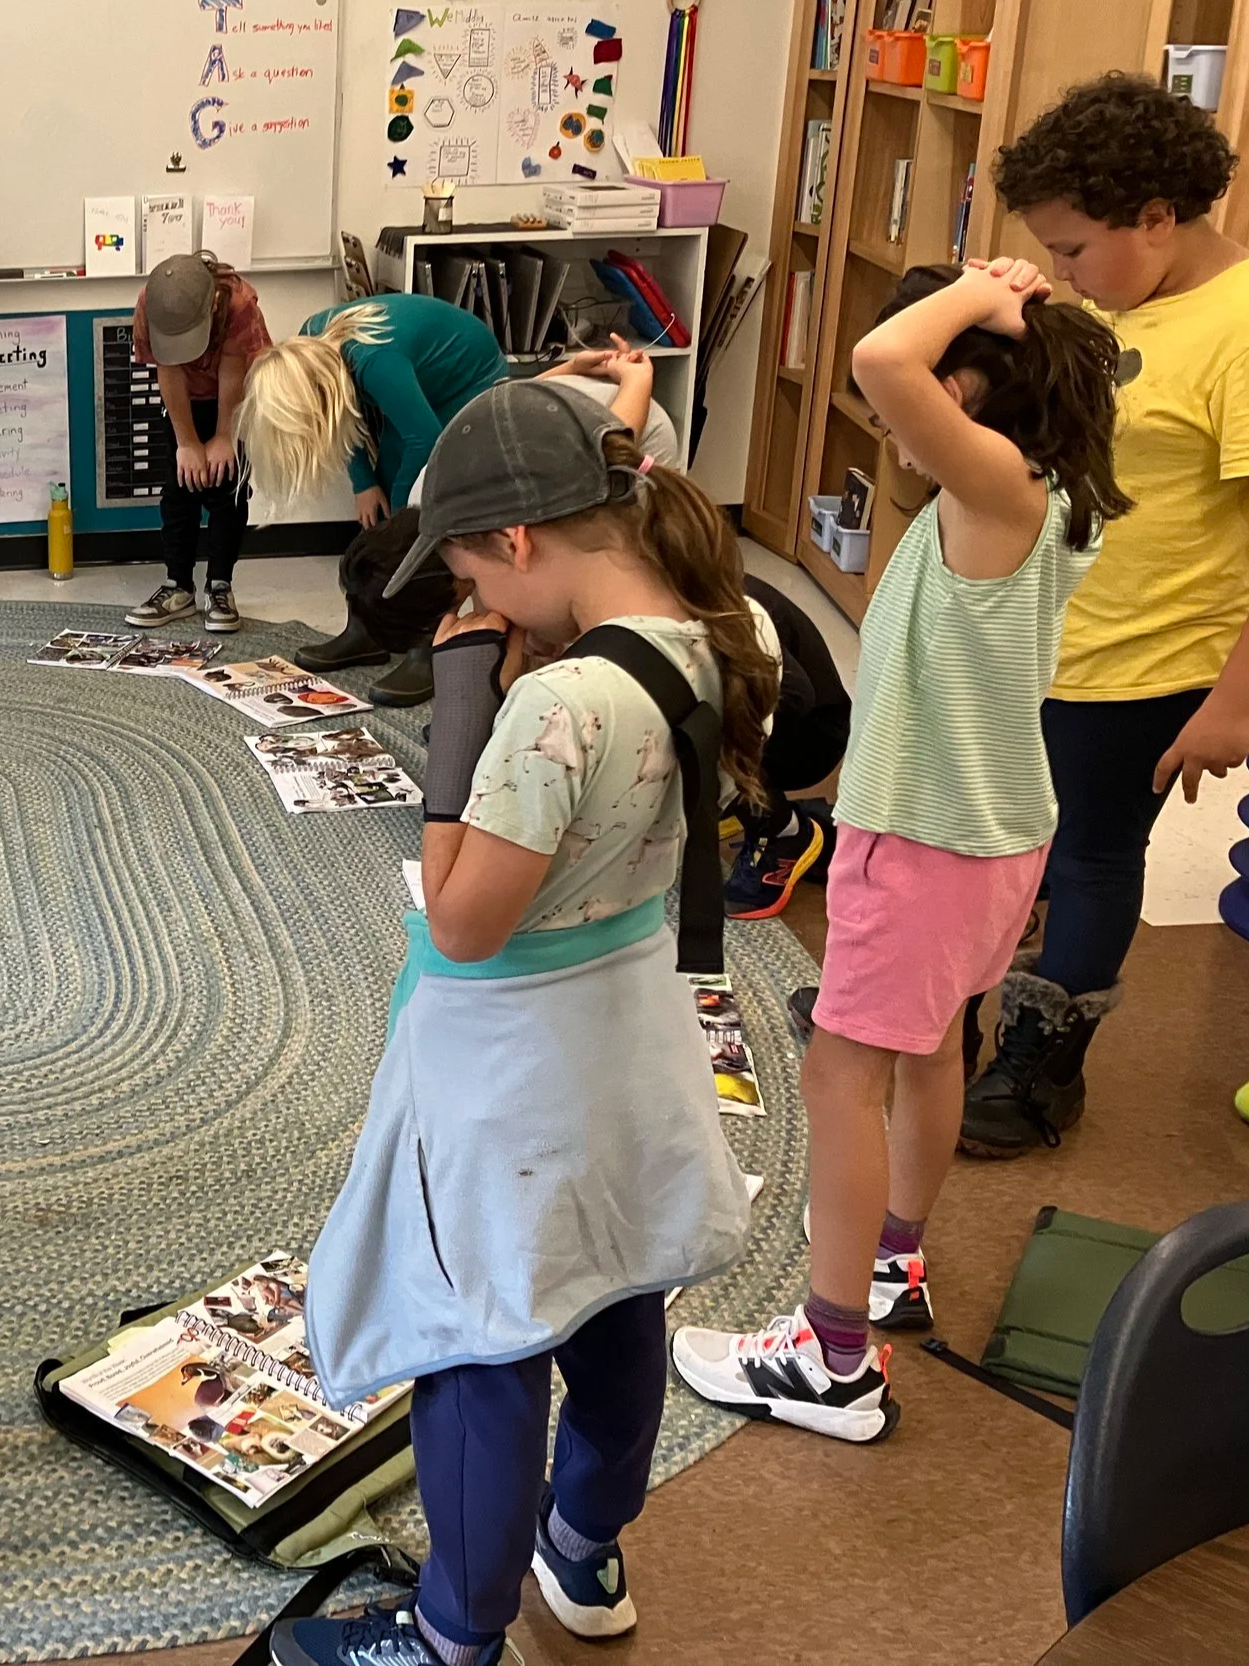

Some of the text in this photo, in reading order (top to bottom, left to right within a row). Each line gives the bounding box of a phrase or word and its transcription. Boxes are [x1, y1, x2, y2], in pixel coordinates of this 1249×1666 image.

[252, 19, 295, 36] something
[313, 19, 334, 32] liked
[263, 66, 314, 86] question
[251, 123, 258, 132] a
[262, 117, 310, 136] suggestion
[206, 202, 242, 217] Thank
[219, 215, 246, 230] you!
